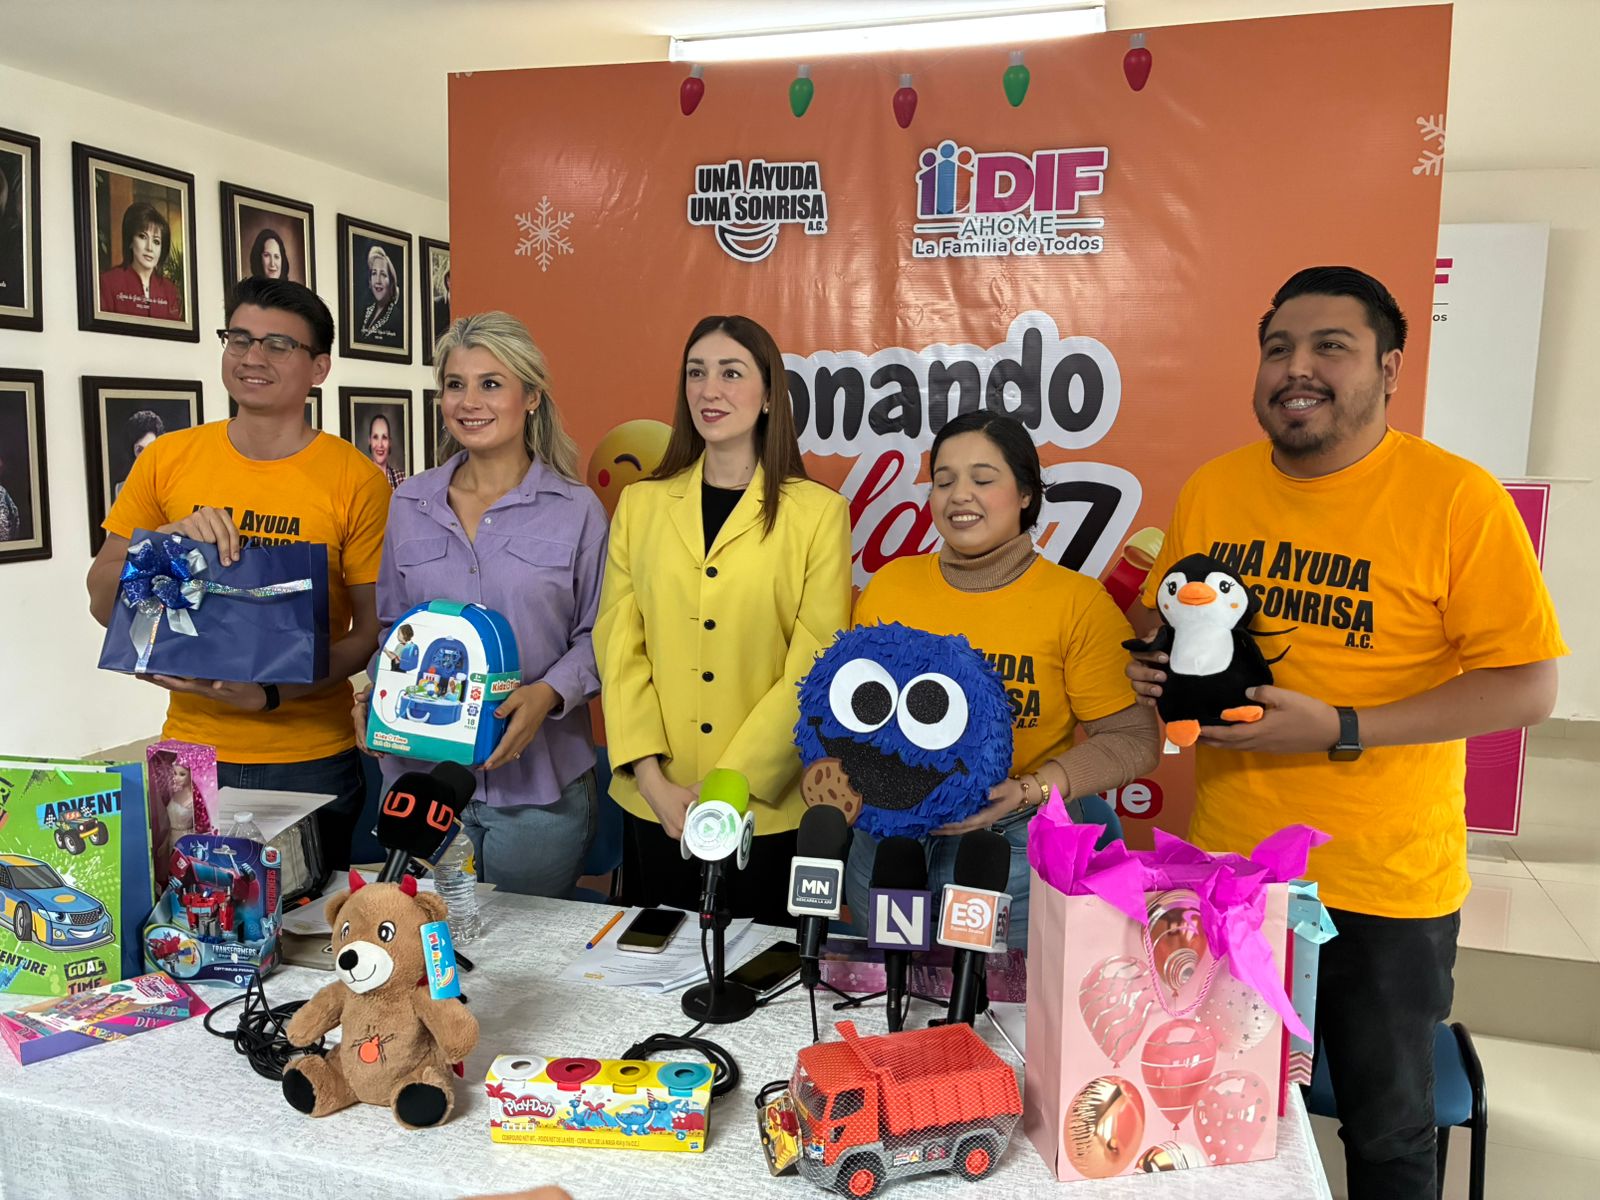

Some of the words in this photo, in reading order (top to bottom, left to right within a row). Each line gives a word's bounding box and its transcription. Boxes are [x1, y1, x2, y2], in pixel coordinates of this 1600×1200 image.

[699, 163, 741, 193] UNA
[749, 163, 818, 191] AYUDA
[975, 151, 1105, 213] DIF
[690, 196, 732, 221] UNA
[734, 194, 825, 221] SONRISA
[807, 221, 825, 231] A.C.
[961, 216, 1054, 237] AHOME
[915, 241, 935, 254] La
[942, 238, 1008, 254] Familia
[1014, 238, 1038, 252] de
[1044, 236, 1100, 251] Todos
[240, 510, 300, 536] AYUDA
[1267, 541, 1372, 593] AYUDA
[1248, 584, 1374, 633] SONRISA
[1344, 632, 1374, 649] A.C.
[801, 879, 830, 896] MN
[951, 901, 987, 929] ES
[68, 960, 103, 977] GOAL
[503, 1098, 553, 1116] Play-Doh
